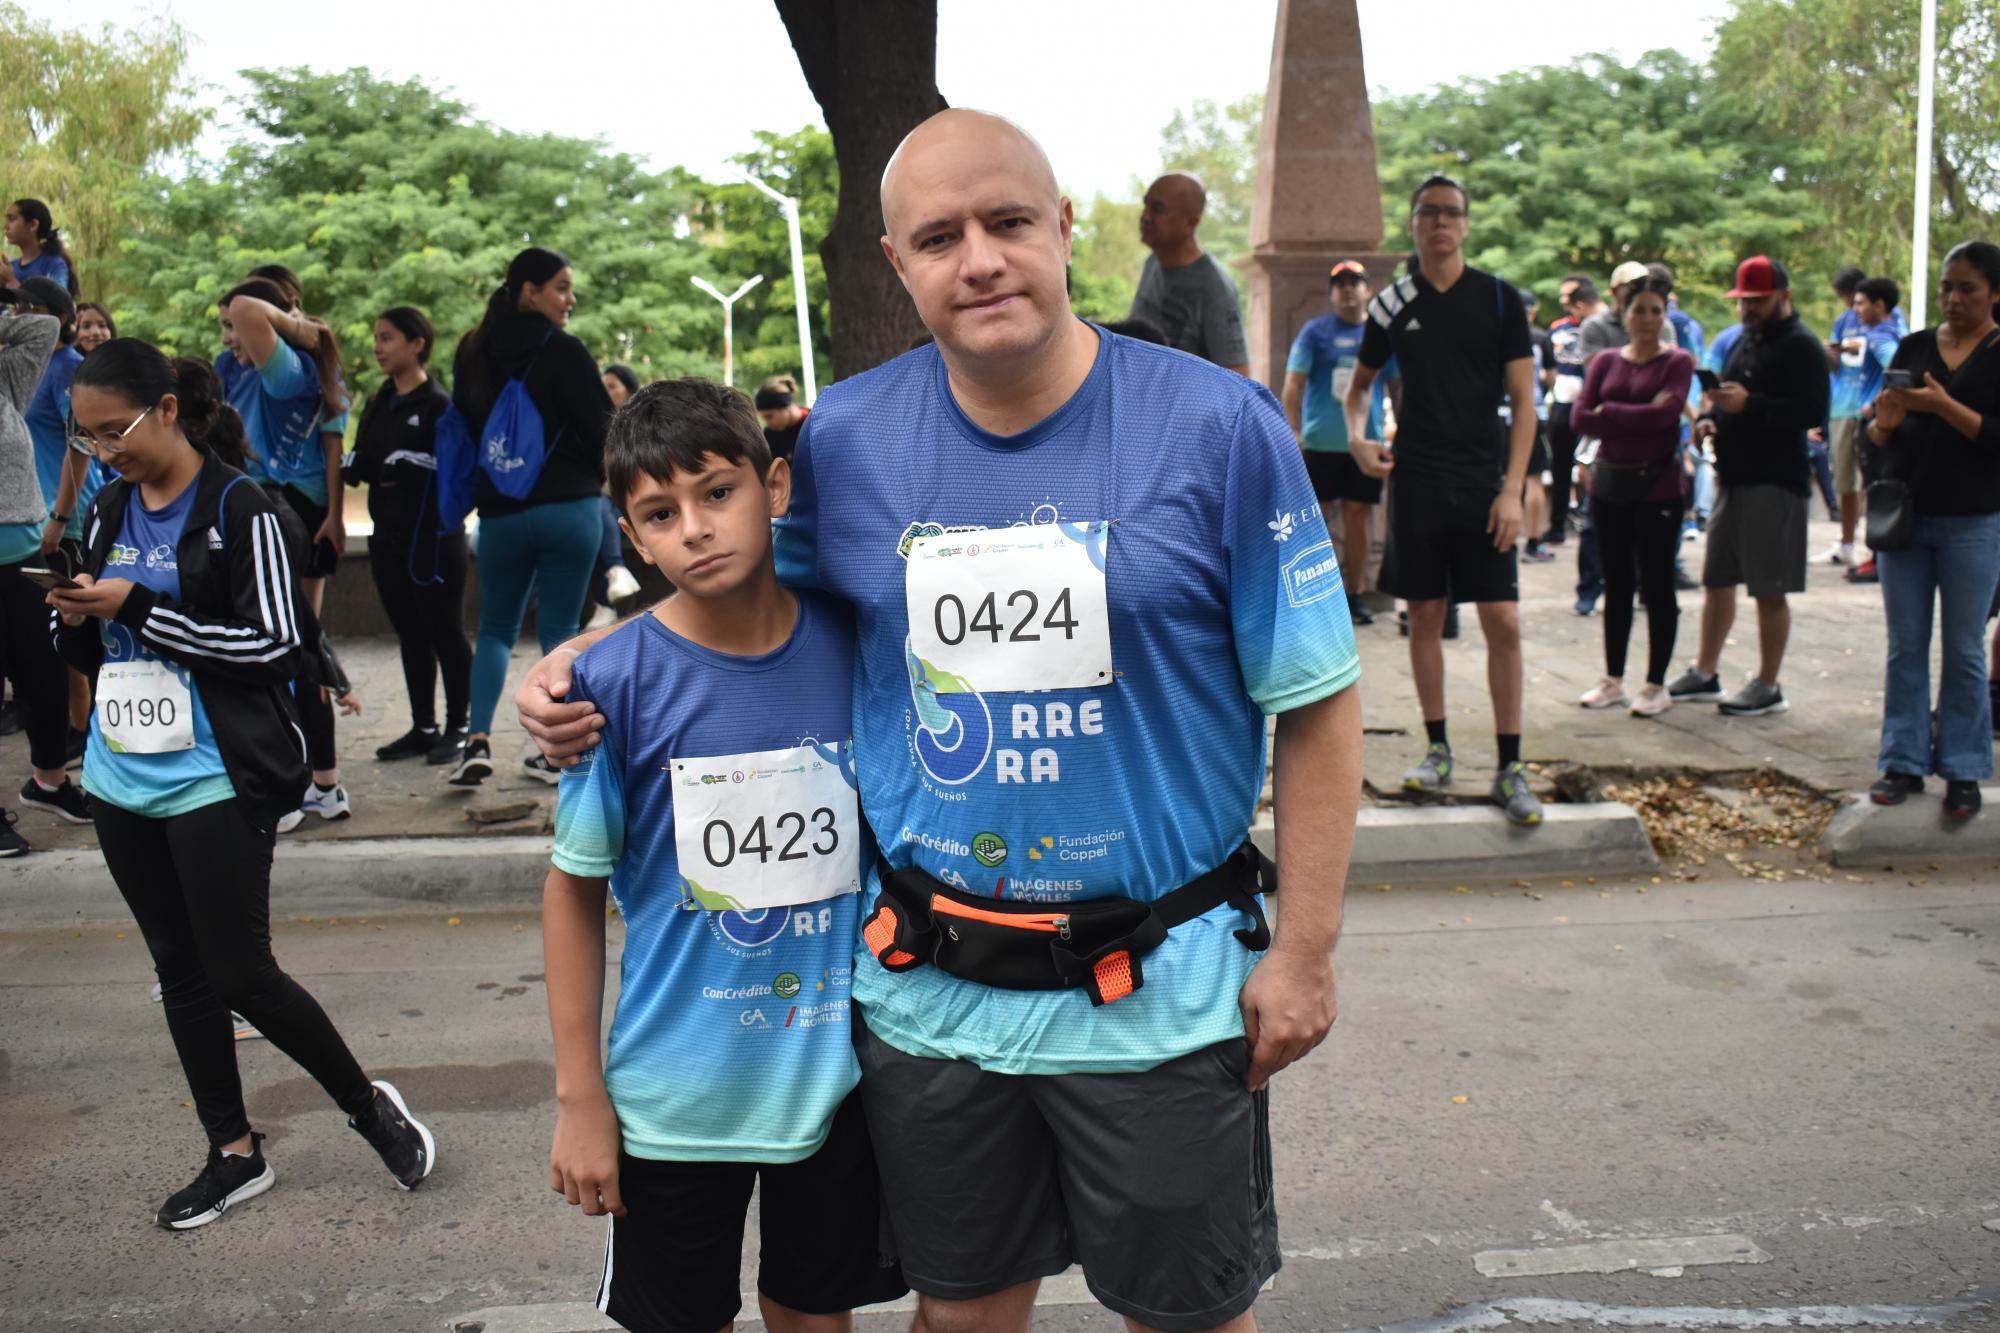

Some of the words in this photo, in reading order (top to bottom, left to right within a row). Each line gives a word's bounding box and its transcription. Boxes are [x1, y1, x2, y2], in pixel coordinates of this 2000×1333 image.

[934, 587, 1079, 646] 0424
[106, 697, 176, 727] 0190
[1011, 699, 1104, 739] RRE
[996, 747, 1060, 784] RA
[703, 806, 839, 868] 0423
[902, 825, 970, 857] ConCrédito
[1058, 829, 1126, 848] Fundación
[1059, 844, 1108, 862] Coppel
[702, 984, 772, 1000] ConCrédito
